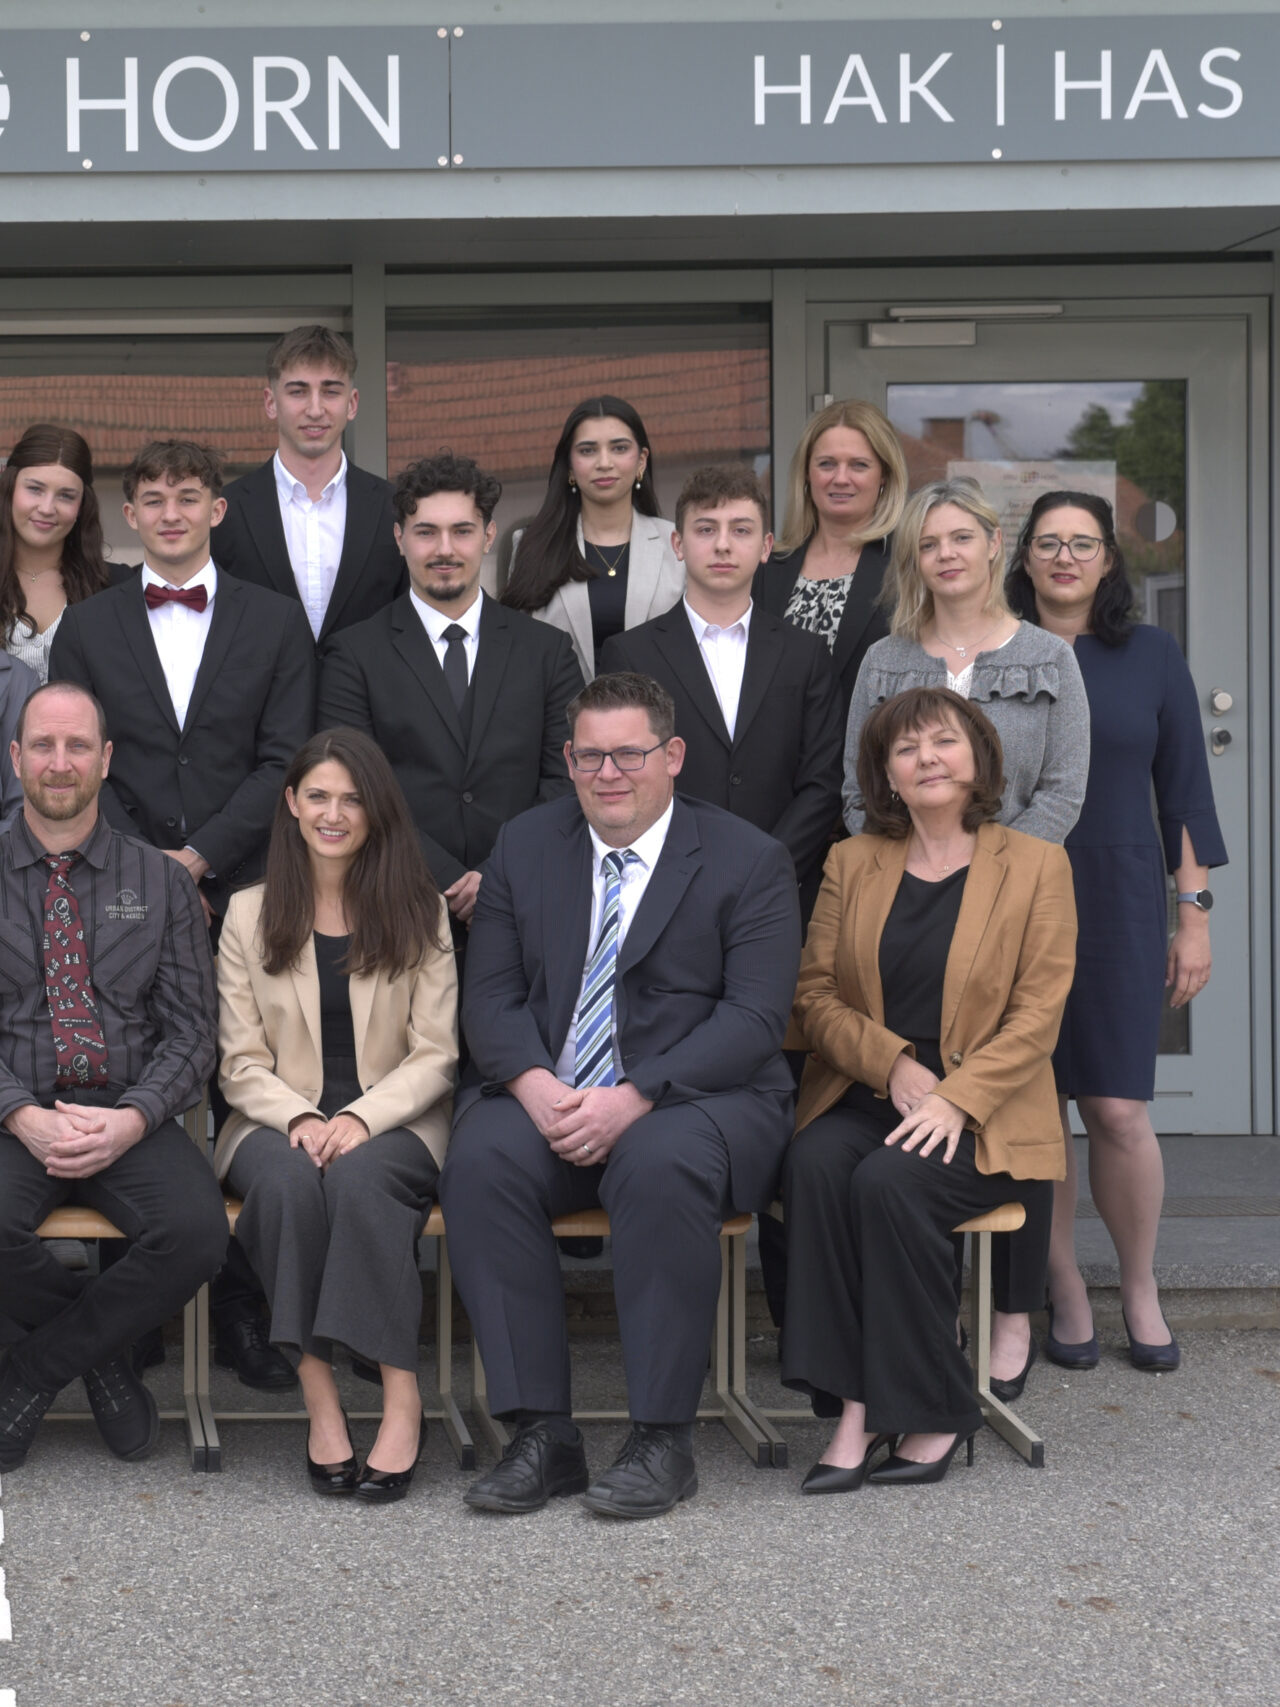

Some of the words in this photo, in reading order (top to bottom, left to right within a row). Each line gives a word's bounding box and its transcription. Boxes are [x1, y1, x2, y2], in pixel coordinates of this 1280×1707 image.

[66, 55, 401, 153] HORN
[753, 52, 955, 125] HAK
[1054, 47, 1244, 121] HAS
[105, 904, 124, 912] URBAN
[124, 905, 148, 913] DISTRICT
